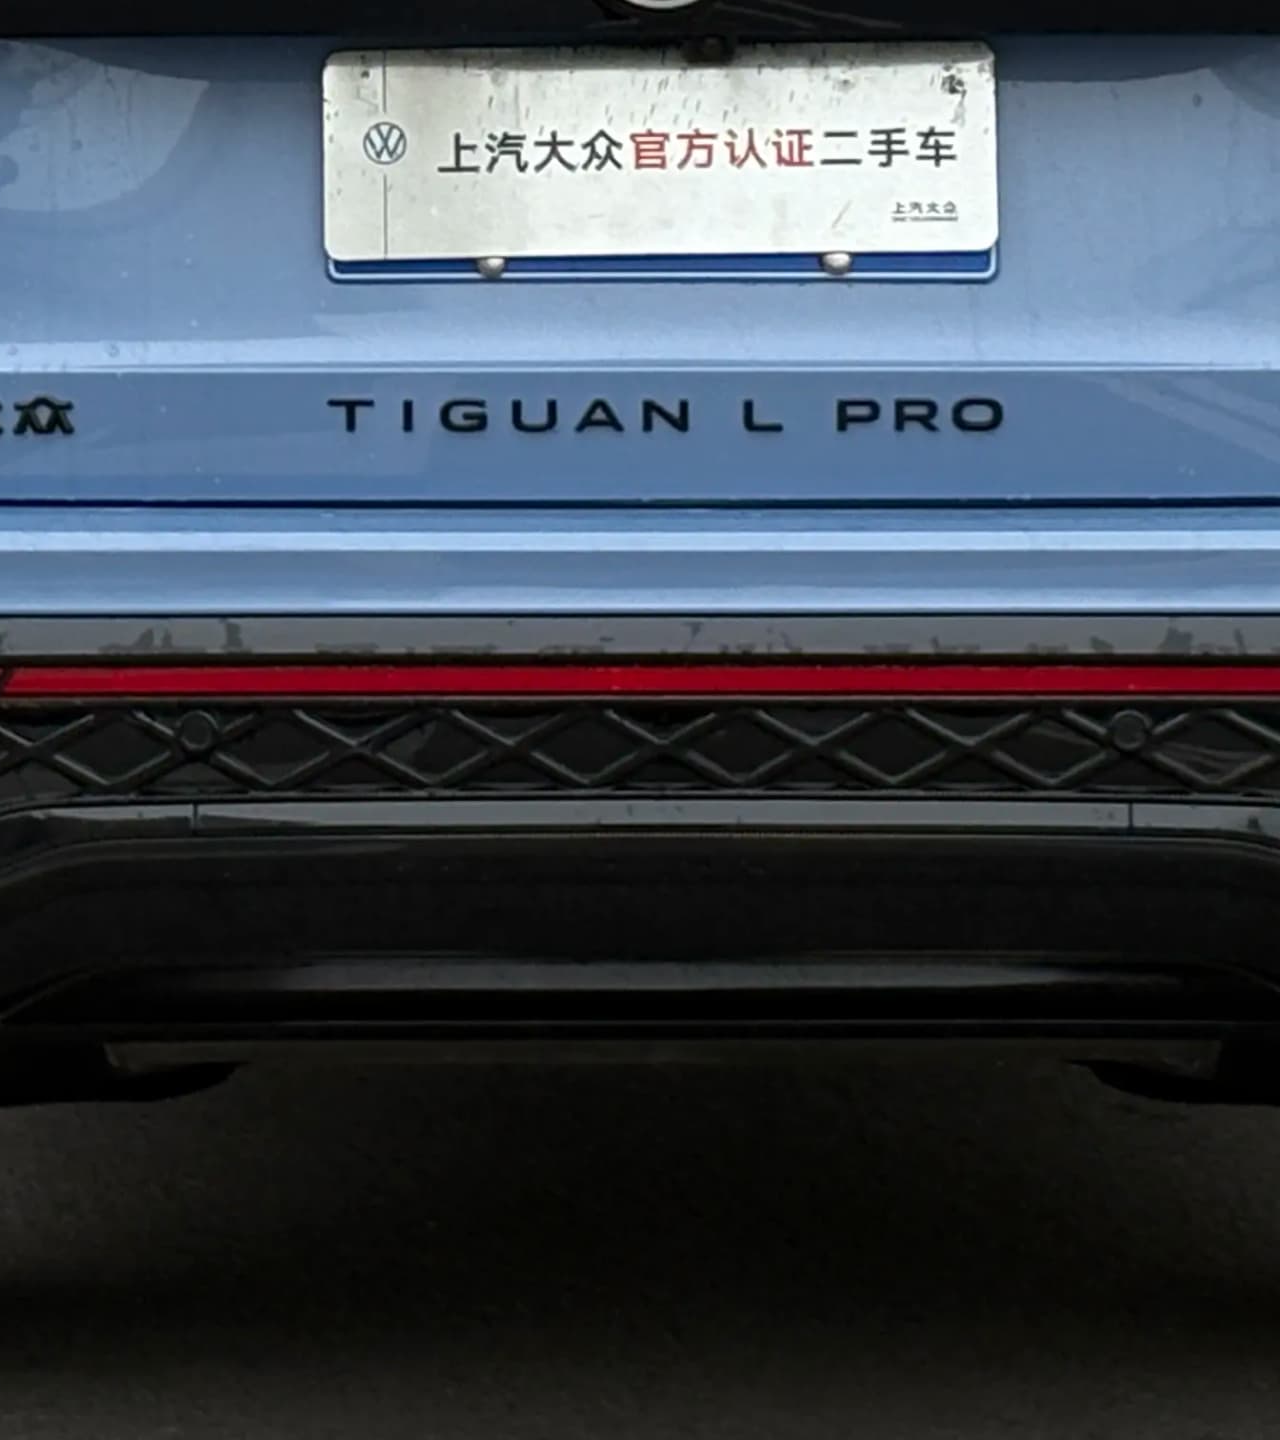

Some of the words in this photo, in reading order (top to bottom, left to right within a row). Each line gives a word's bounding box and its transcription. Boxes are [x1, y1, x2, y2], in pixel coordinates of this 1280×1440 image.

[437, 127, 958, 174] 上汽大众官方认证二手车
[327, 398, 690, 433] TIGUAN
[743, 399, 784, 433] L
[836, 398, 1004, 433] PRO
